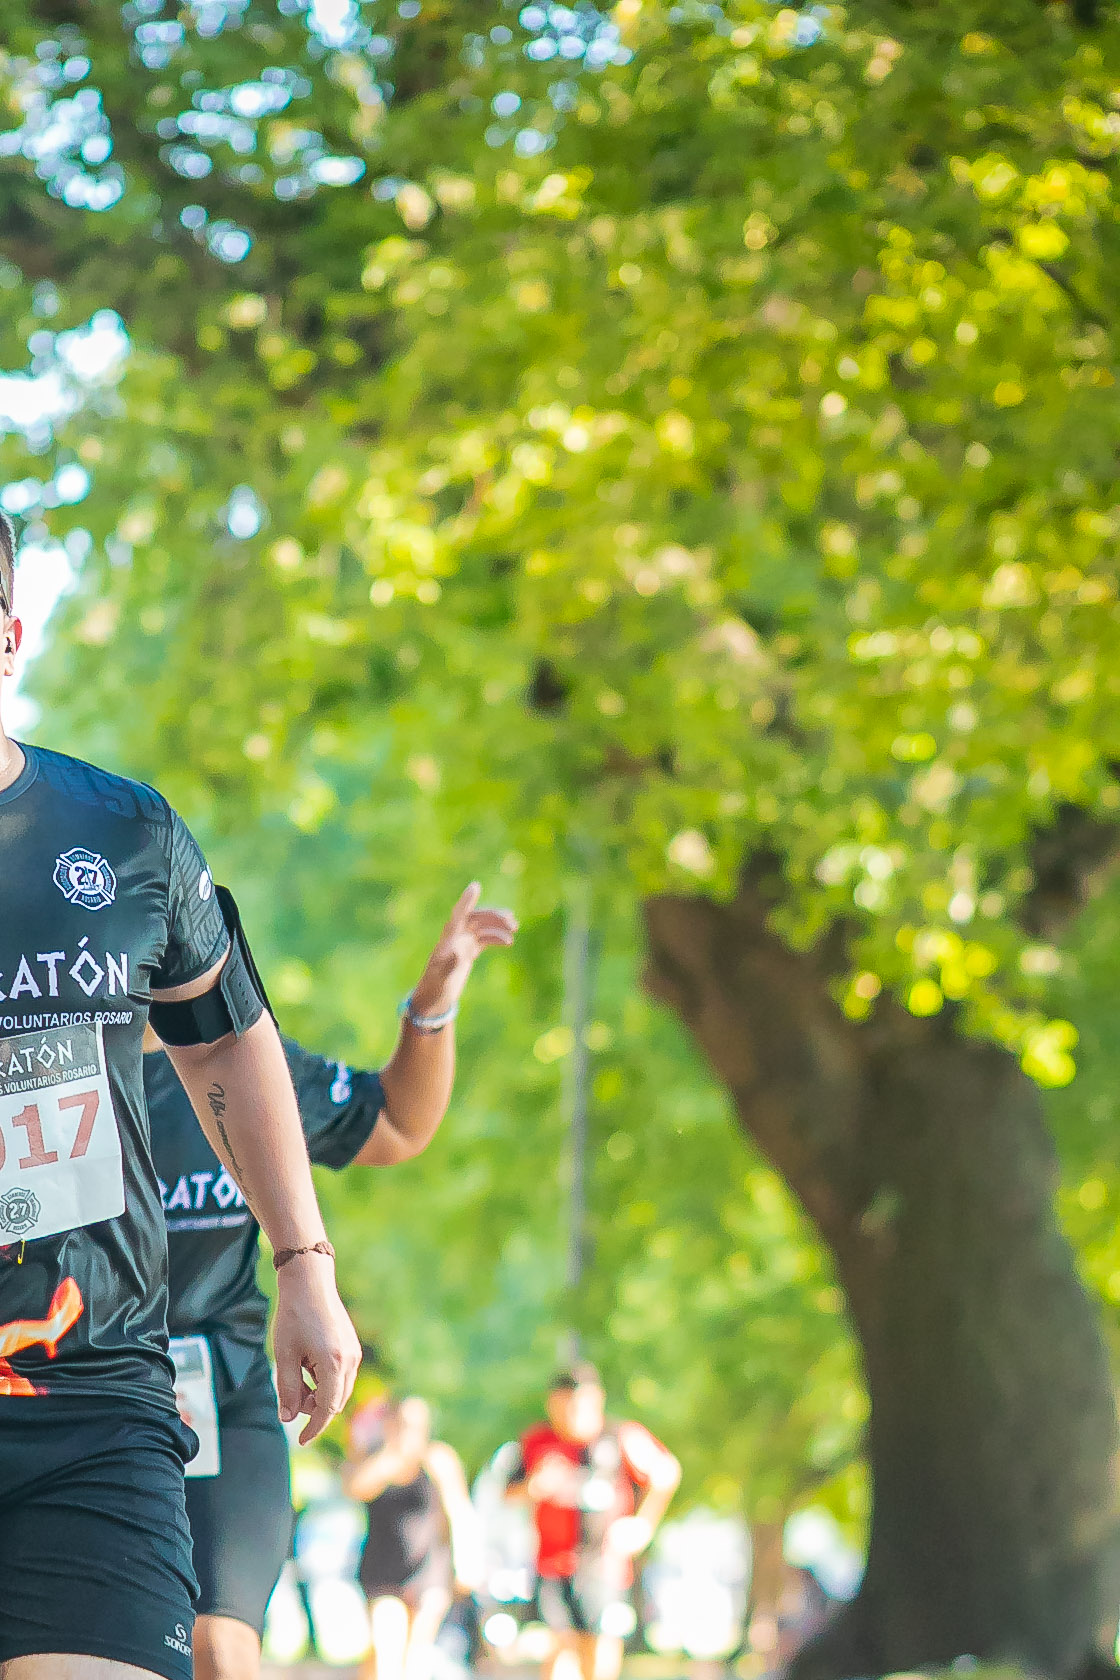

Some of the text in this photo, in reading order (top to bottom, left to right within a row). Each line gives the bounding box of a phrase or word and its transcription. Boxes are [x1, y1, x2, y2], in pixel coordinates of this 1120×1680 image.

[74, 865, 98, 886] 27
[94, 1011, 133, 1025] ROSARIO
[4, 1072, 61, 1094] VOLUNTARIOS
[62, 1063, 98, 1082] ROSARIO
[9, 1201, 28, 1220] 27
